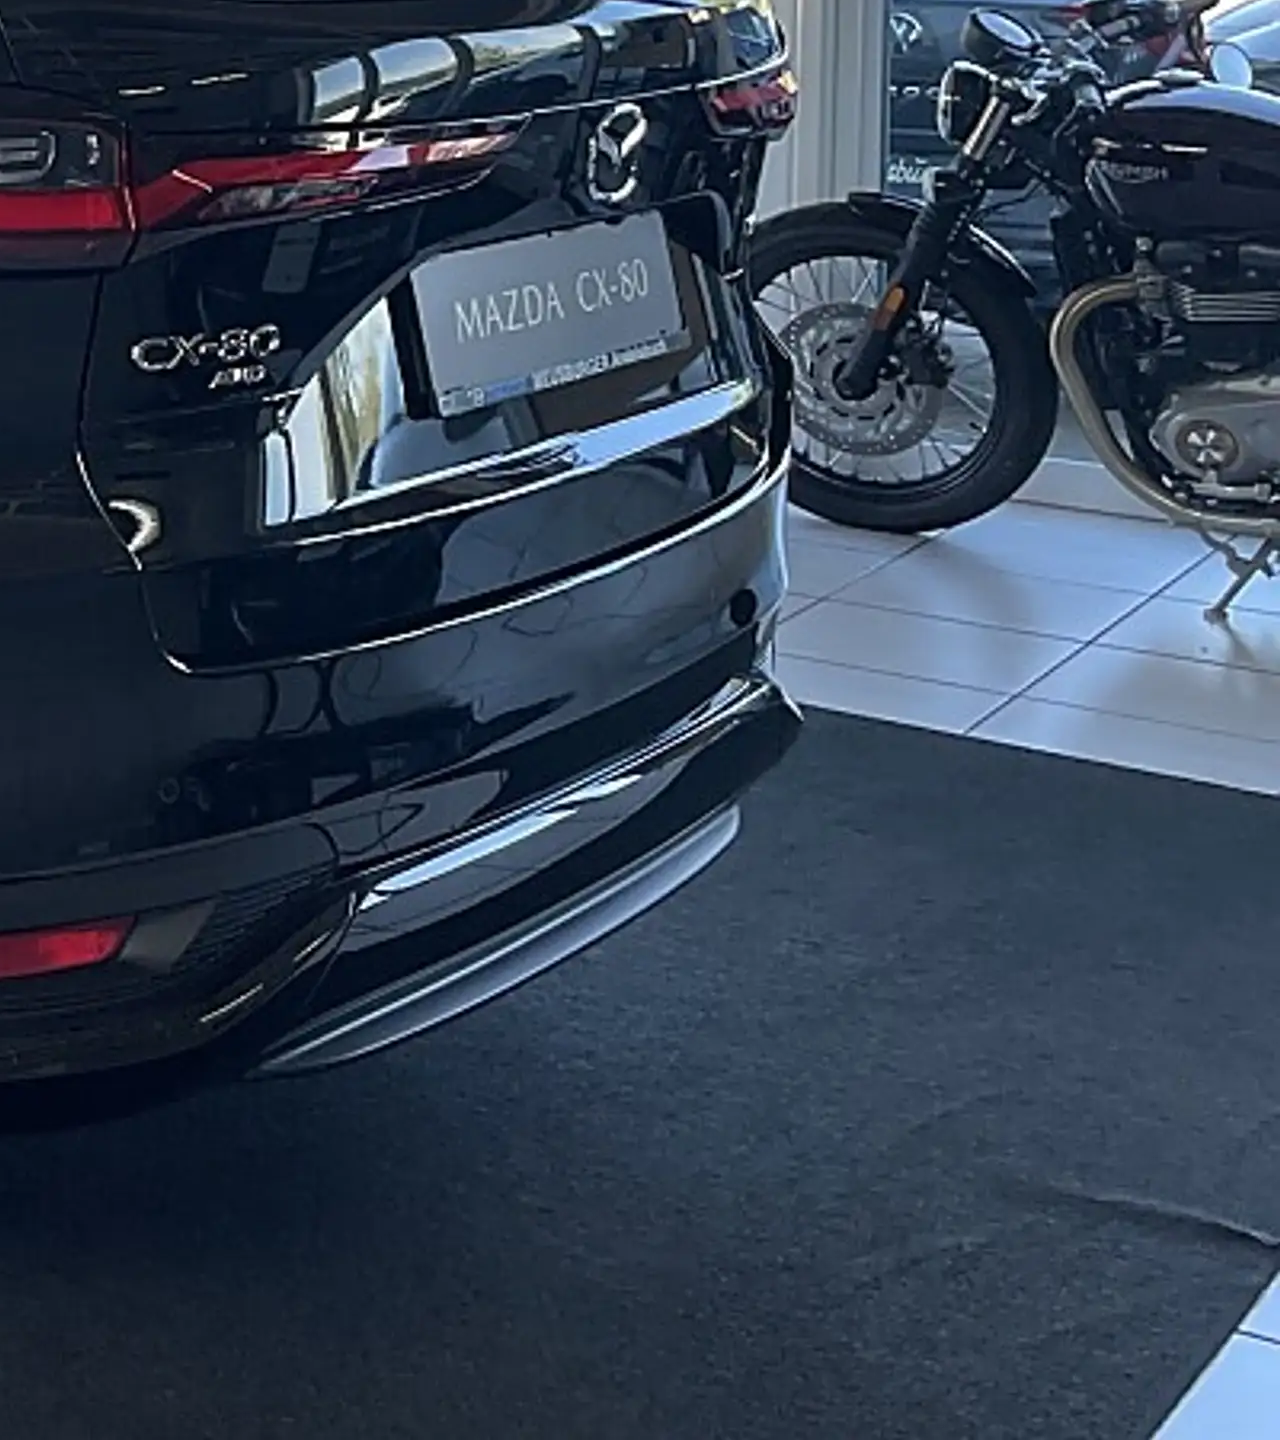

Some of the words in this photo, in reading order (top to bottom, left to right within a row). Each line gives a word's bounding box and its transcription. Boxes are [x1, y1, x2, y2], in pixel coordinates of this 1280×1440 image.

[454, 281, 566, 343] MAZDA
[575, 258, 650, 312] CX-80
[131, 323, 280, 371] CX-80
